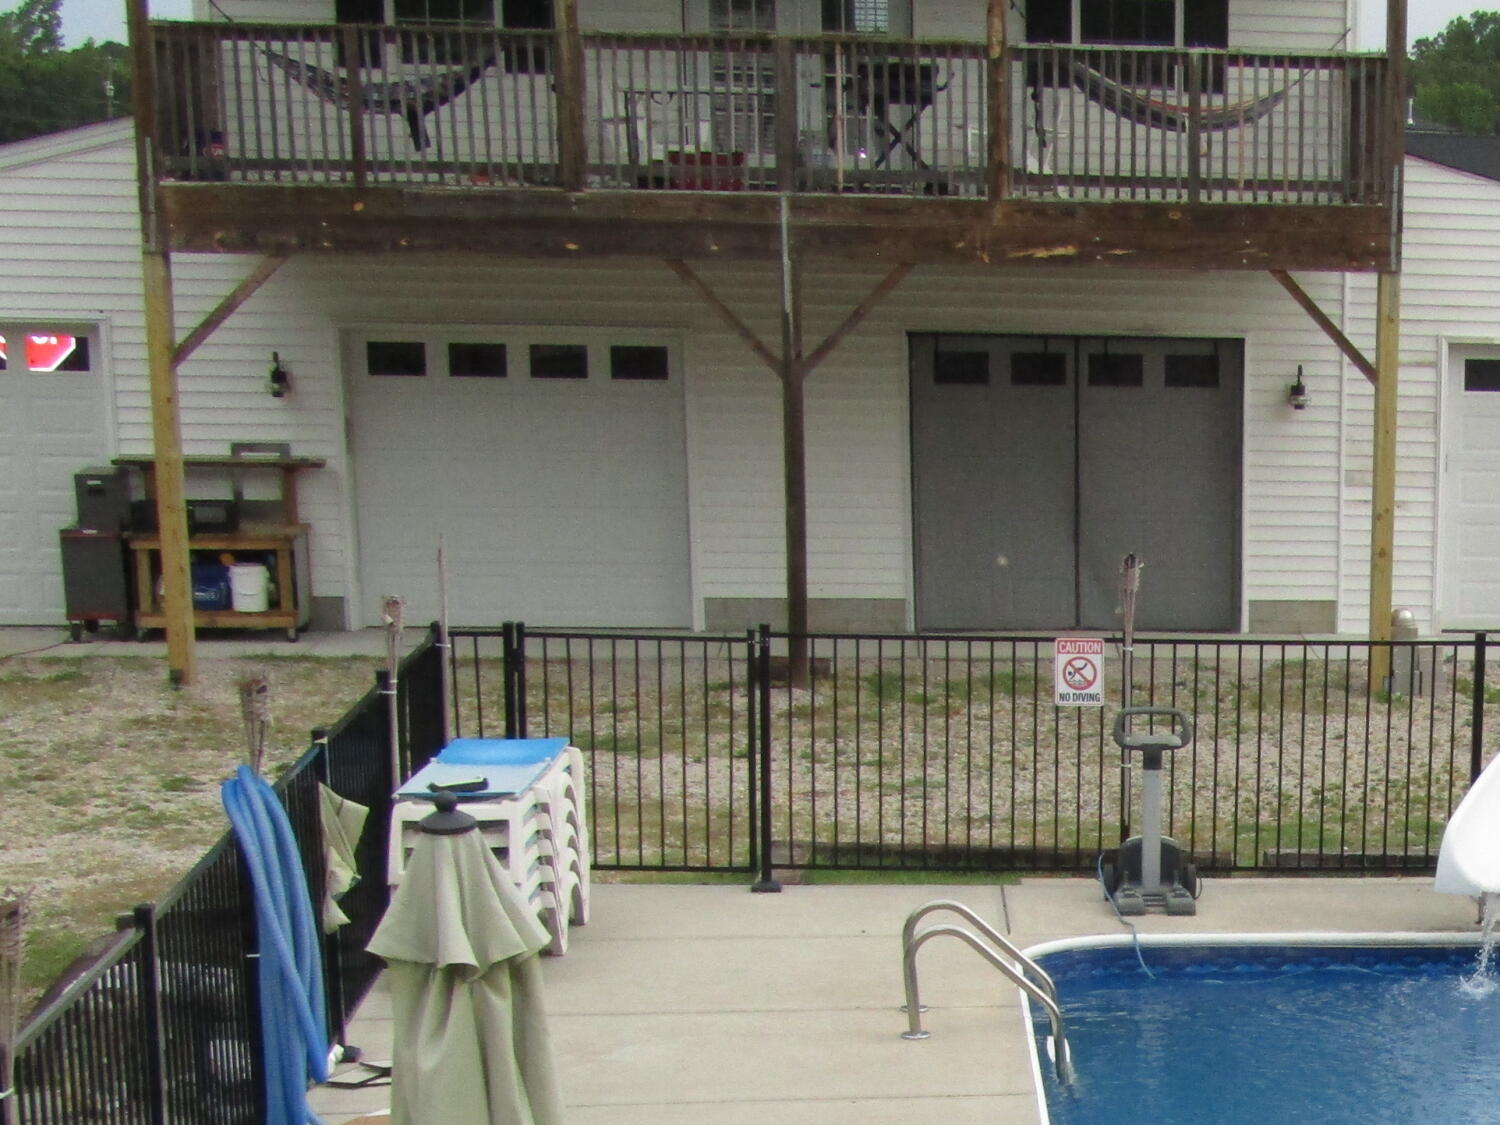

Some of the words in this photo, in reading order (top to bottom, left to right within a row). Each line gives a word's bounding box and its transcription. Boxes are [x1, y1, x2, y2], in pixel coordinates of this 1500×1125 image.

[1059, 642, 1101, 653] CAUTION
[1059, 692, 1071, 702] NO
[1072, 692, 1101, 702] DIVING
